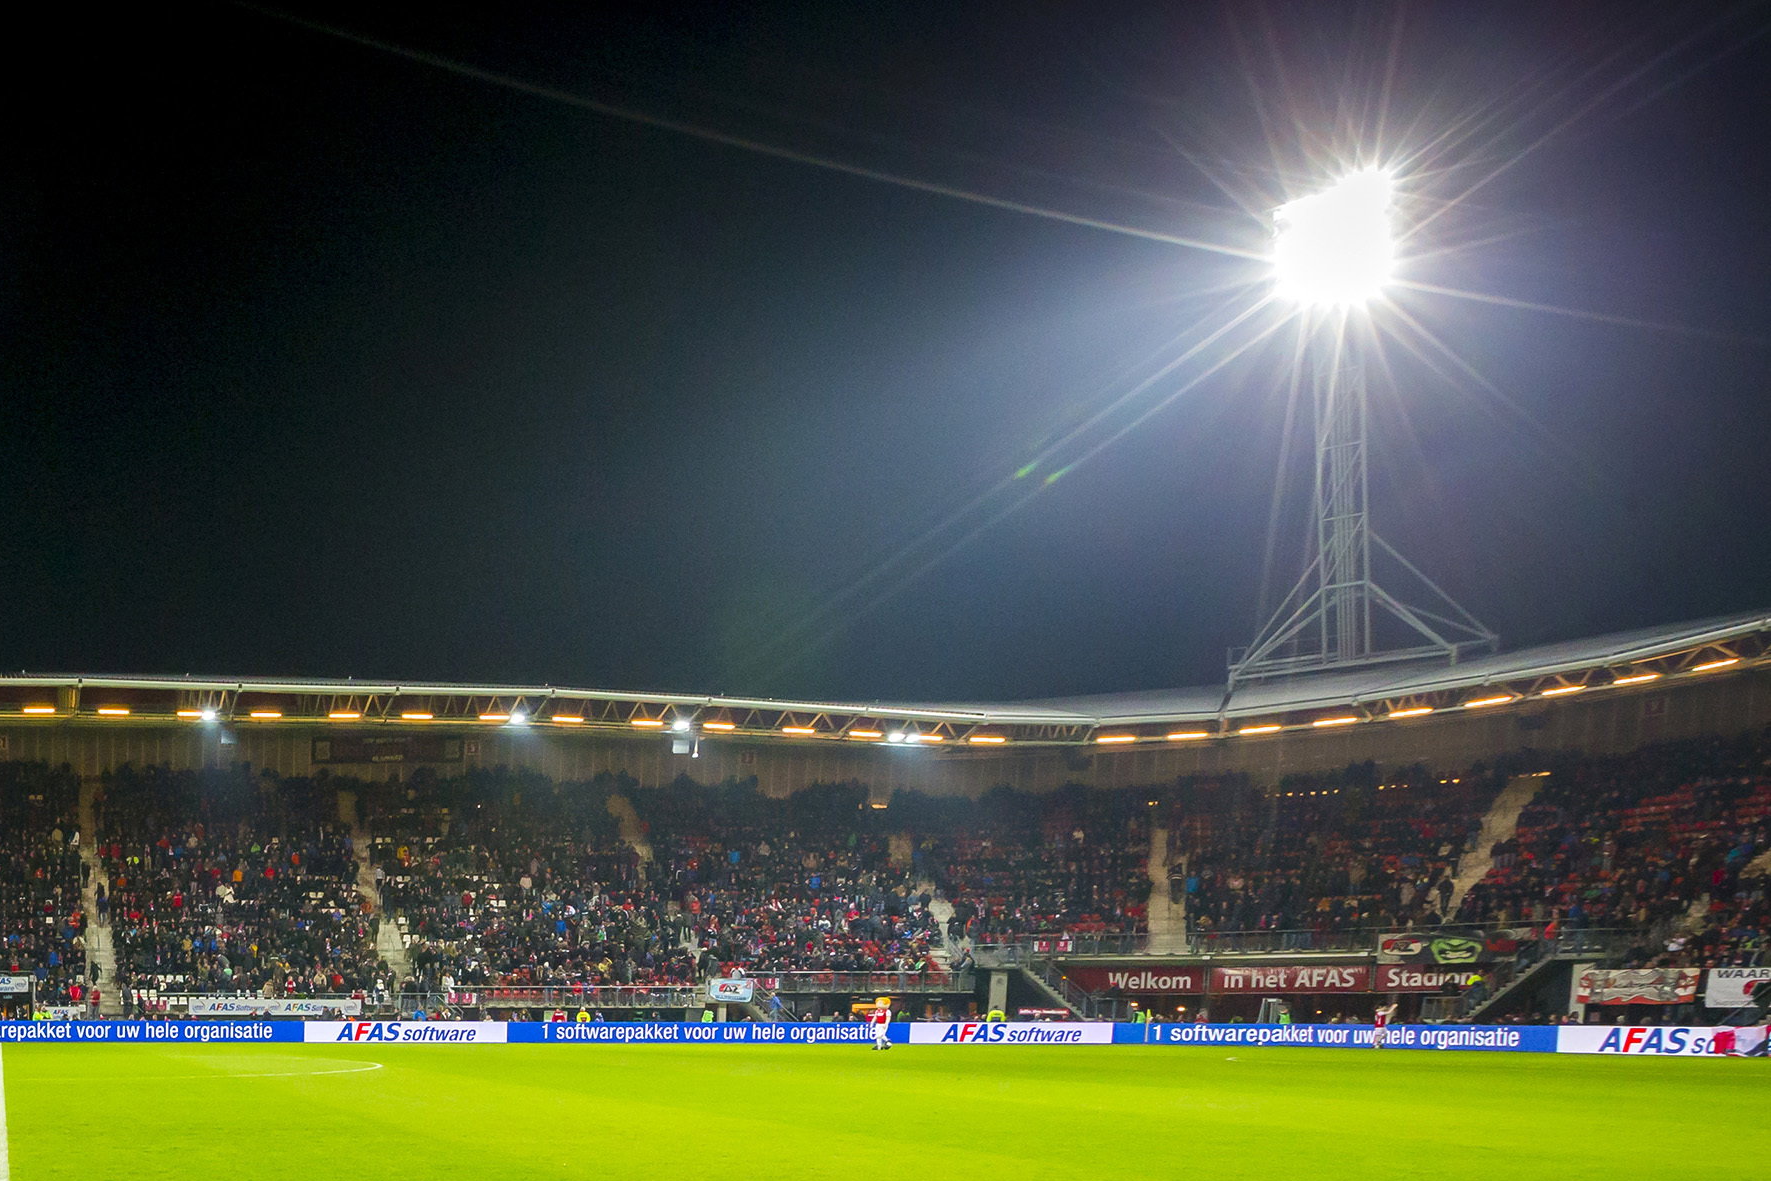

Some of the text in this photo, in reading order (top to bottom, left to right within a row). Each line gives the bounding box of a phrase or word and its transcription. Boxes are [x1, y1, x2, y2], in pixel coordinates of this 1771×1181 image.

[1108, 971, 1192, 990] Welkom
[1224, 971, 1243, 988] in
[1251, 970, 1287, 988] het
[1294, 969, 1355, 988] AFAS
[209, 1002, 235, 1011] AFAS
[284, 1002, 311, 1011] AFAS
[76, 1025, 111, 1039] voor
[116, 1025, 140, 1039] uw
[145, 1021, 179, 1039] hele
[184, 1021, 273, 1042] organisatie
[336, 1022, 477, 1042] AFAS software
[541, 1022, 879, 1044] 1 softwarepakket voor uw hele organisatie
[941, 1023, 1082, 1043] AFAS software
[1153, 1025, 1161, 1041] 1
[1170, 1024, 1314, 1046] softwarepakket
[1317, 1029, 1350, 1044] voor
[1353, 1029, 1377, 1045] uw
[1420, 1027, 1520, 1050] organisatie
[1598, 1027, 1690, 1054] AFAS
